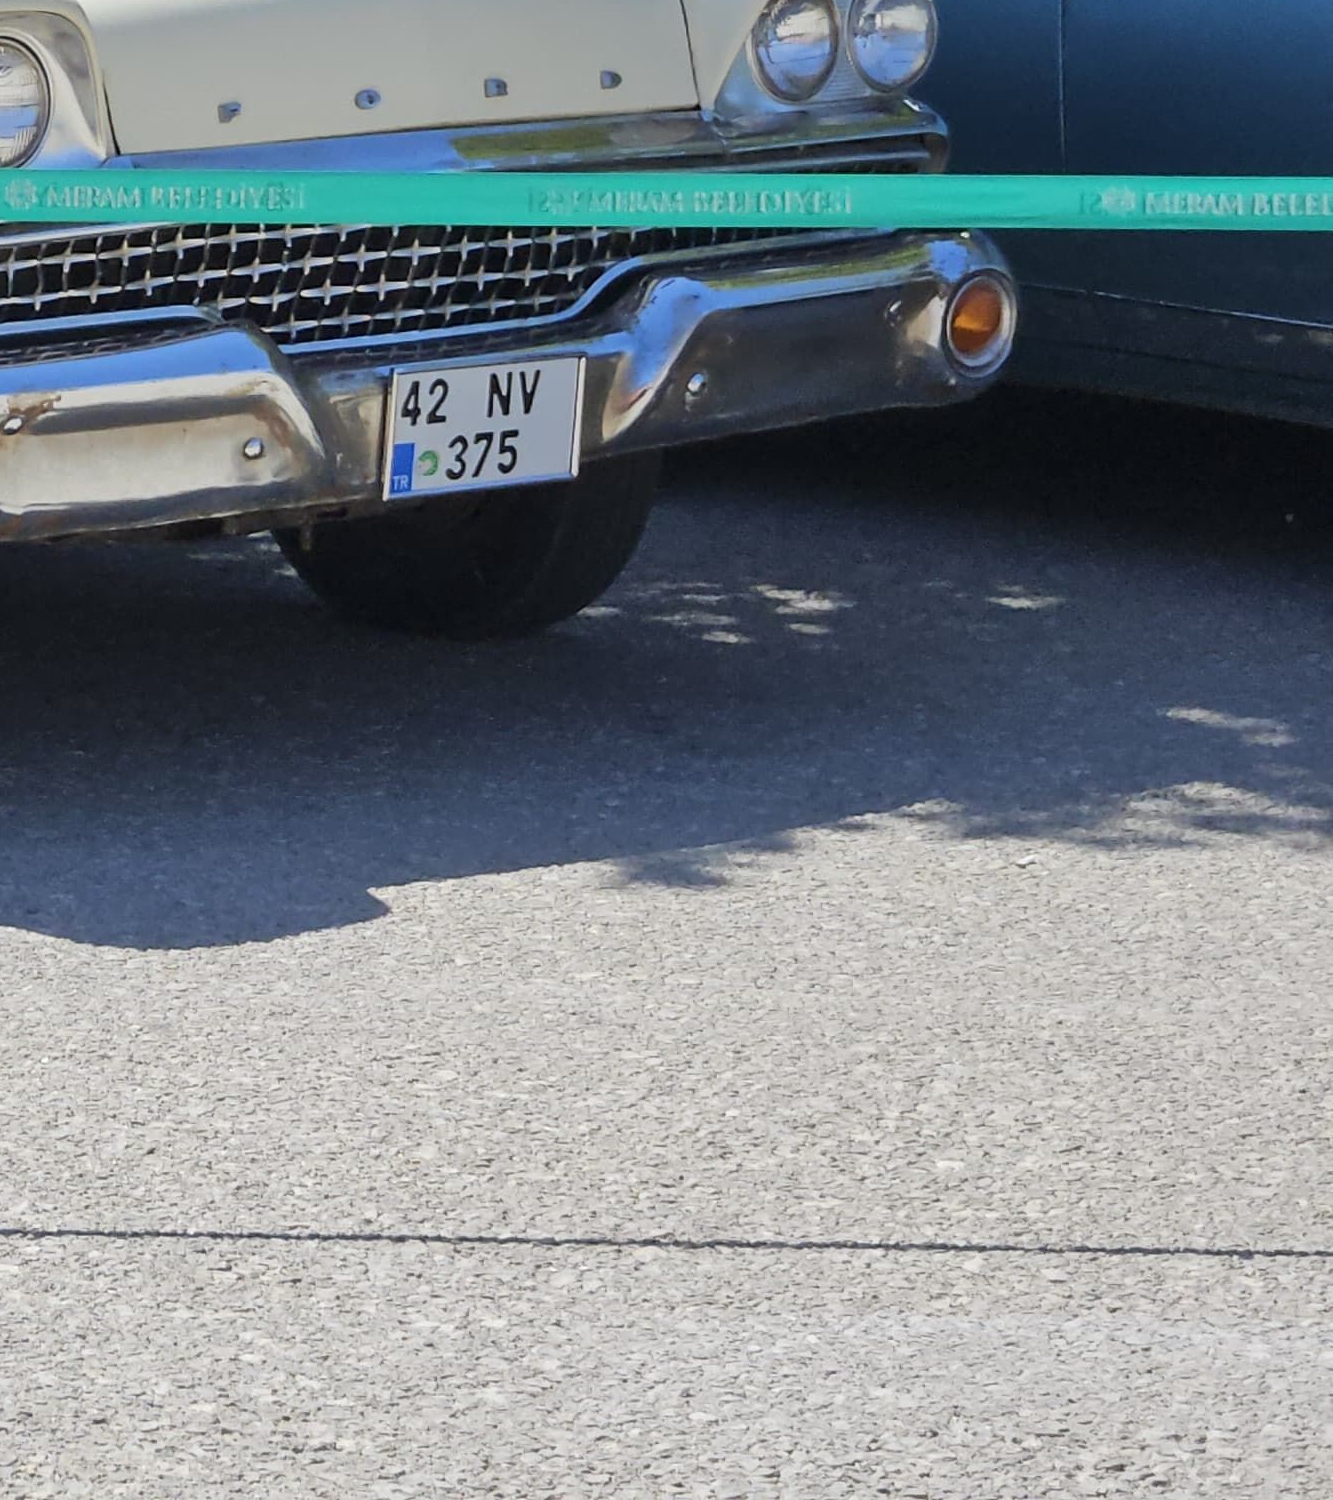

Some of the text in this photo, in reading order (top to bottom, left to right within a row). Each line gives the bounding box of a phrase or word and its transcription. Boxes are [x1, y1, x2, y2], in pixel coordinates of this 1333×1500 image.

[1144, 192, 1243, 216] MERAM
[401, 370, 541, 426] 42 NV
[445, 429, 520, 480] 375
[393, 474, 410, 490] TR
